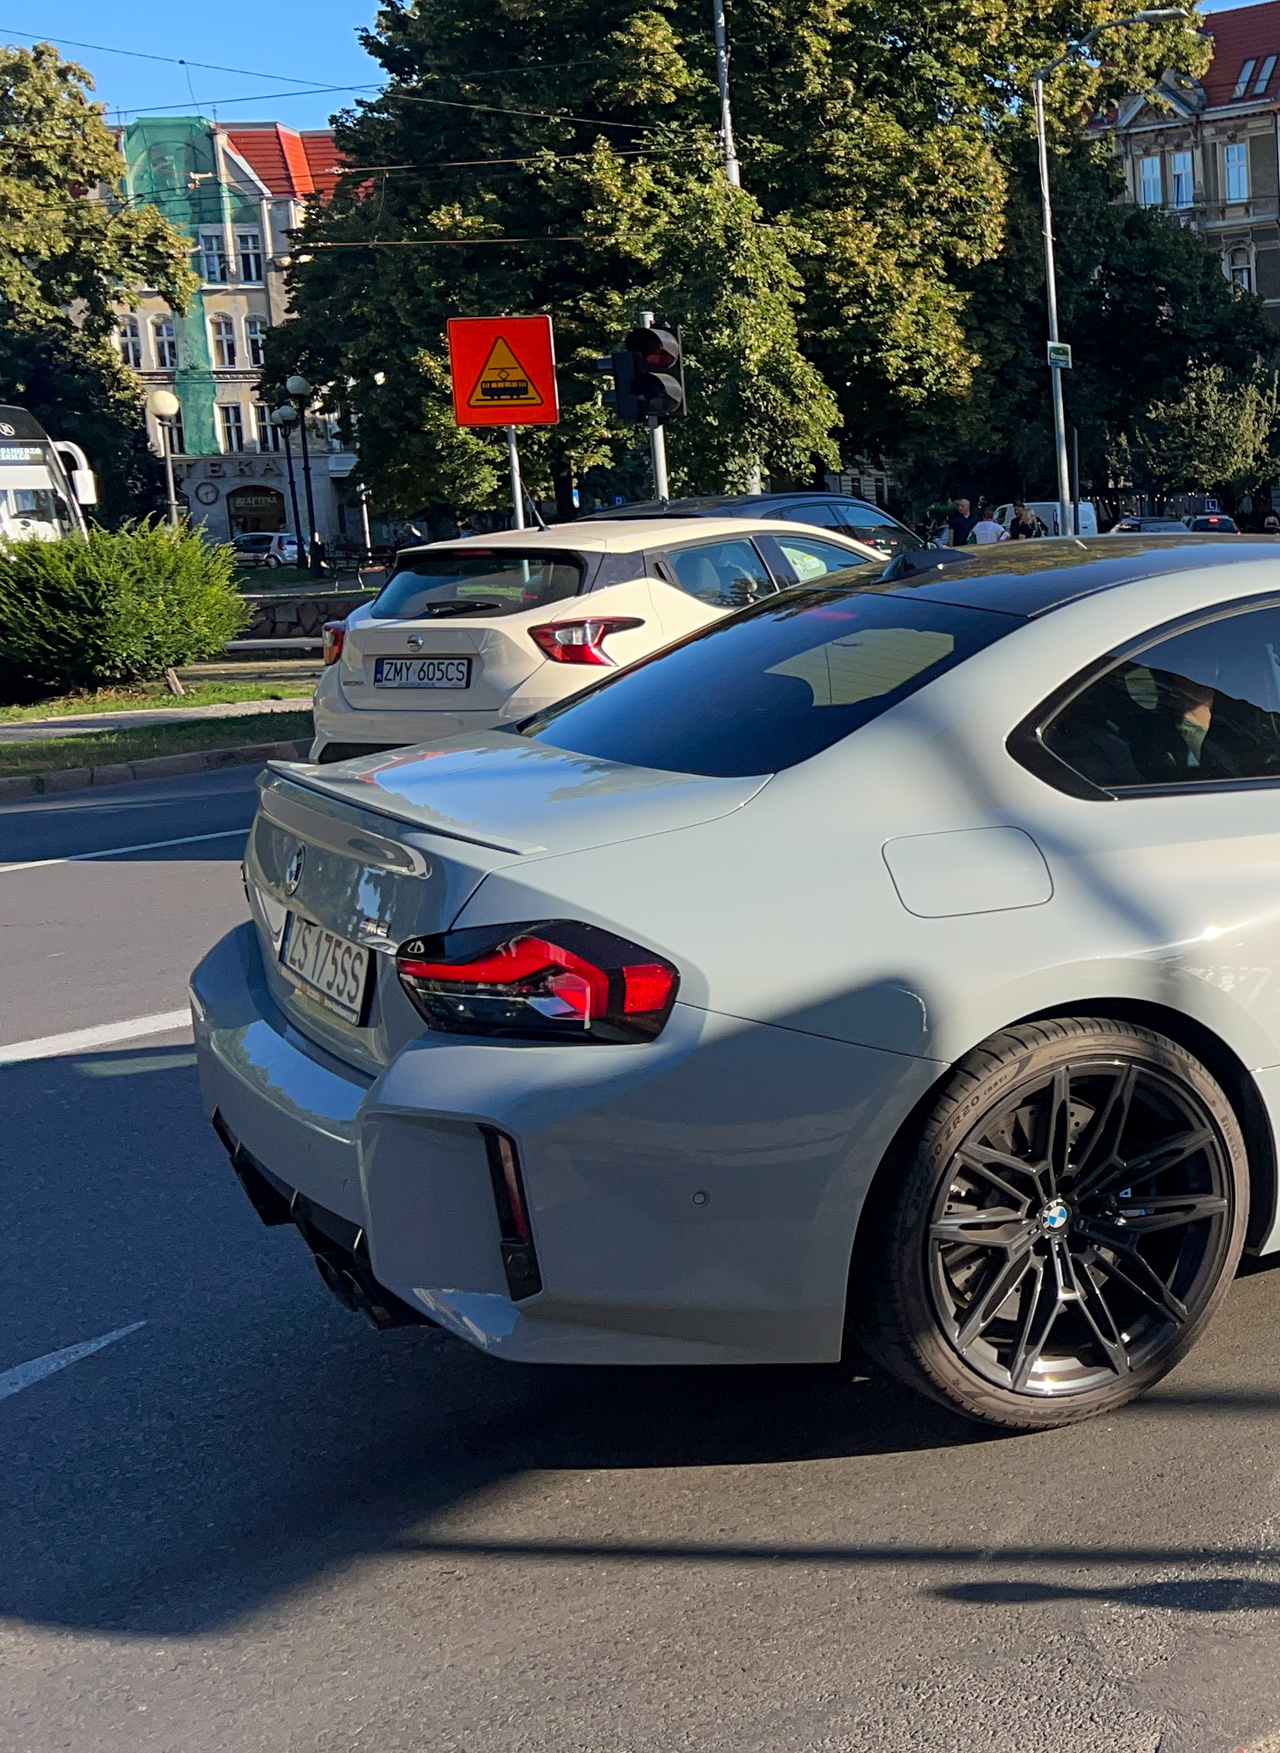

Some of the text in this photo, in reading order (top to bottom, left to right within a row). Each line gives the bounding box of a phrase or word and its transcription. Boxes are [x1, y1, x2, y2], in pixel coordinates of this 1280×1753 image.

[384, 662, 466, 682] ZMY 605CS
[289, 916, 364, 1004] ZS 175SS
[944, 1095, 980, 1141] ZR20
